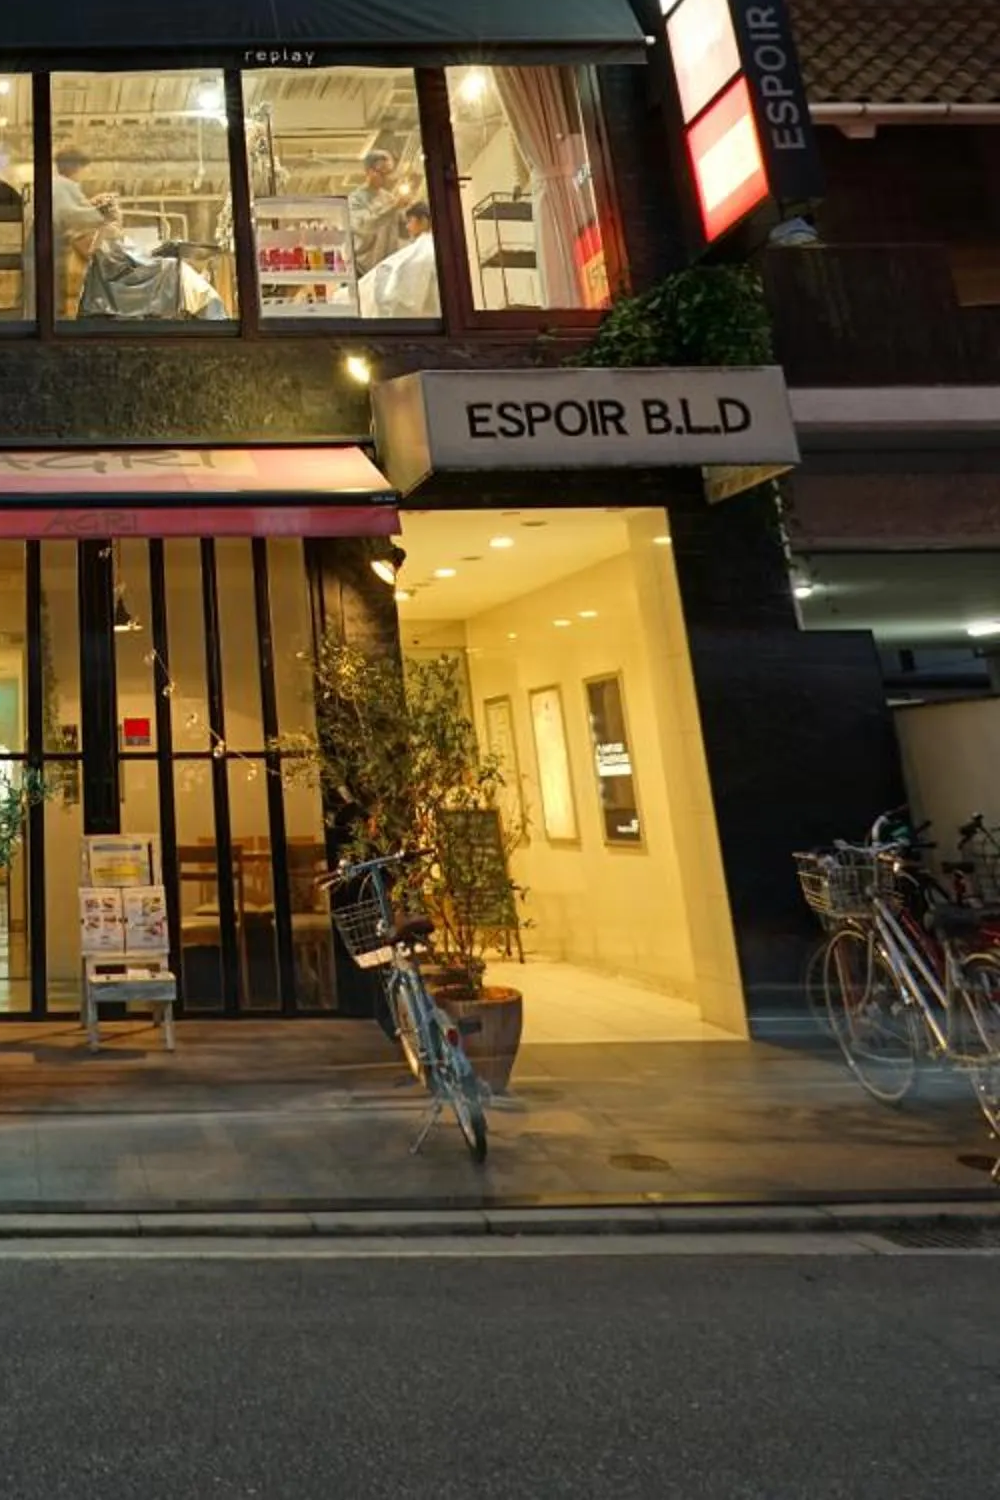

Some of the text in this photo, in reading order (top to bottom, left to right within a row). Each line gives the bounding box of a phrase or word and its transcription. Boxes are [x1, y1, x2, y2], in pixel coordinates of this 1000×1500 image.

[244, 46, 316, 65] replay
[745, 6, 805, 149] ESPOIR
[466, 397, 752, 438] ESPOIR B.L.D
